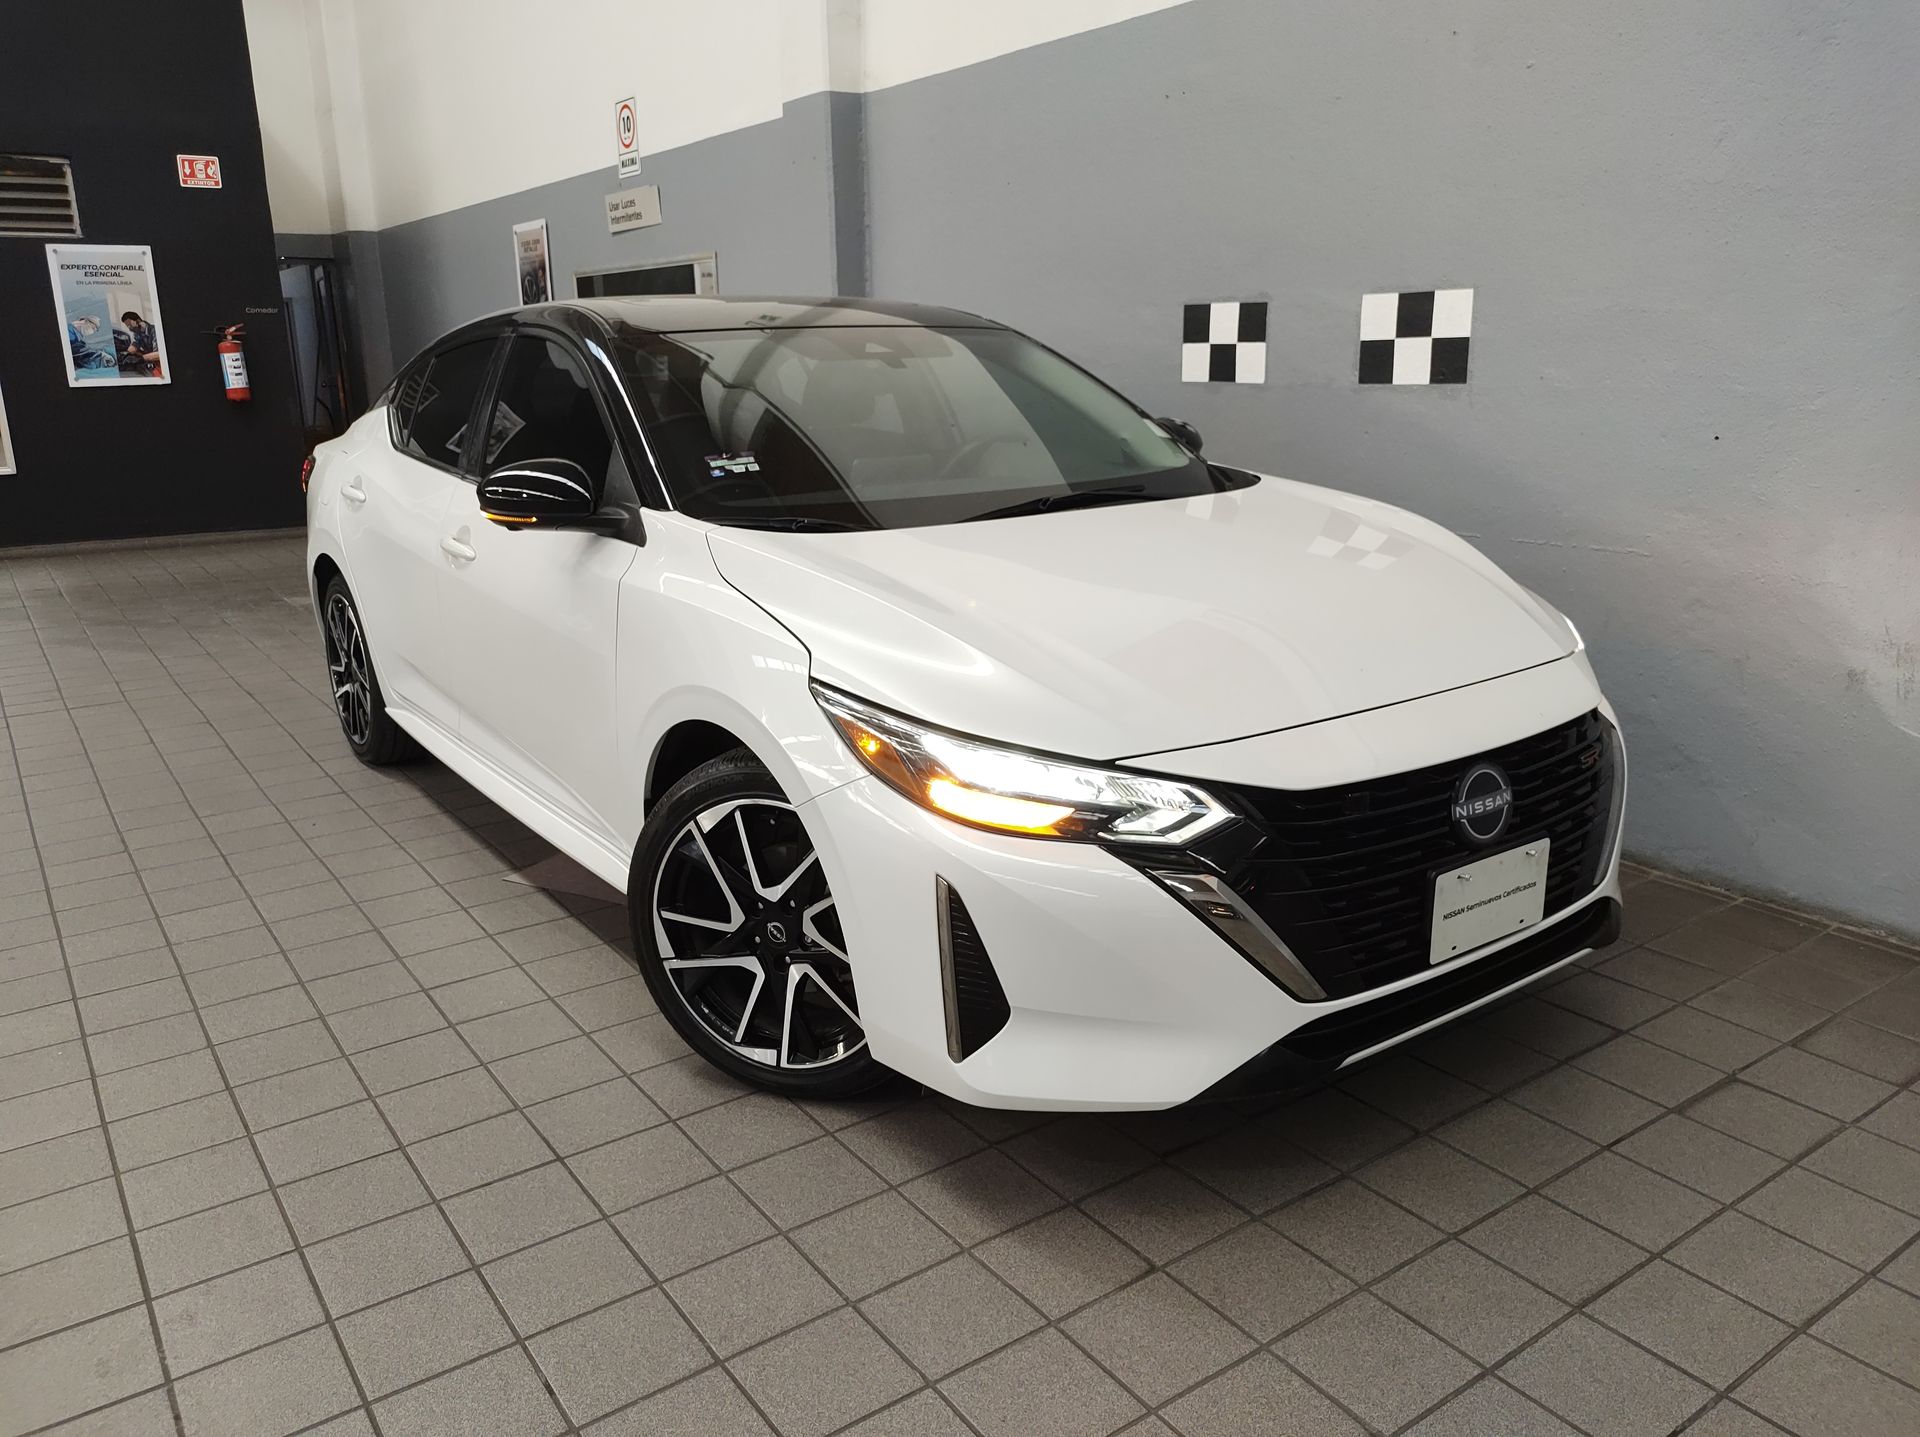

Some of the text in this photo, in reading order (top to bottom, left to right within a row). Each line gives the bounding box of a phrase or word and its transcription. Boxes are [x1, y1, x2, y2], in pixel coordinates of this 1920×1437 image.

[622, 115, 632, 134] 10
[608, 199, 636, 212] Usar Luces
[1455, 791, 1512, 818] NISSAN
[1442, 881, 1537, 921] NISSAN Seminuevos Certificados
